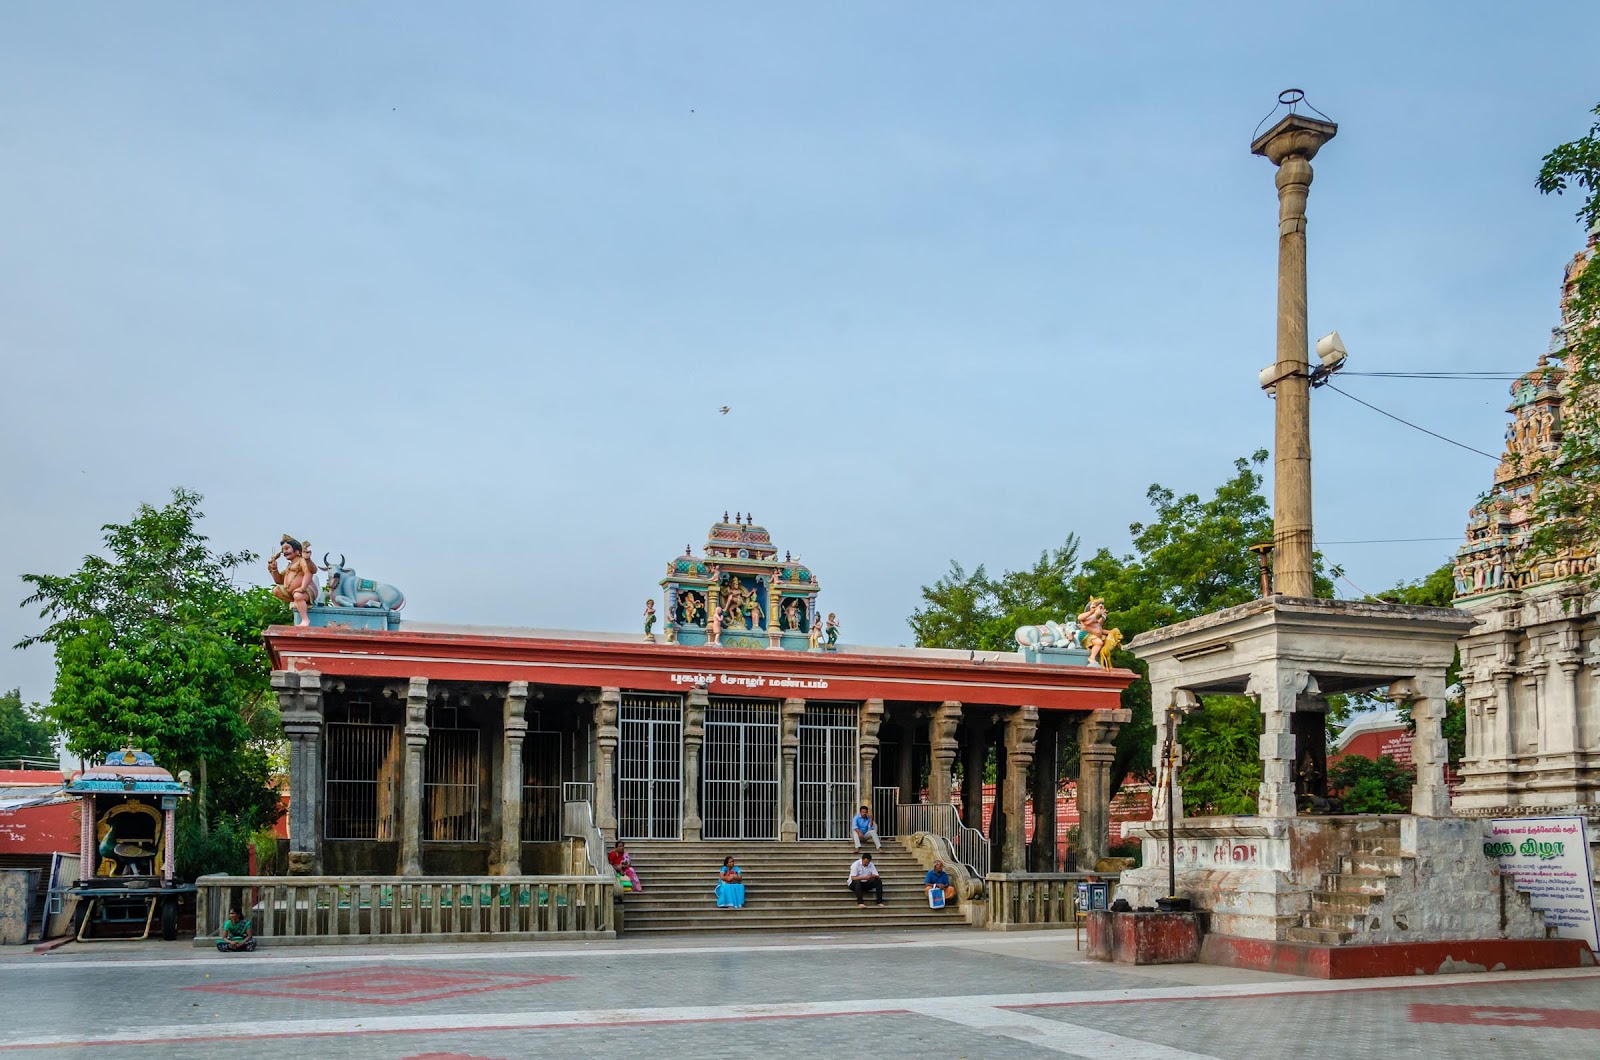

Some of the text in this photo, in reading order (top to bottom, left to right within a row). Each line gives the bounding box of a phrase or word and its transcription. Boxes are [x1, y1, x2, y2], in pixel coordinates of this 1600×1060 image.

[671, 673, 828, 689] புகழ்ச் சோழர் மண்டபம்
[1520, 838, 1564, 860] விழா
